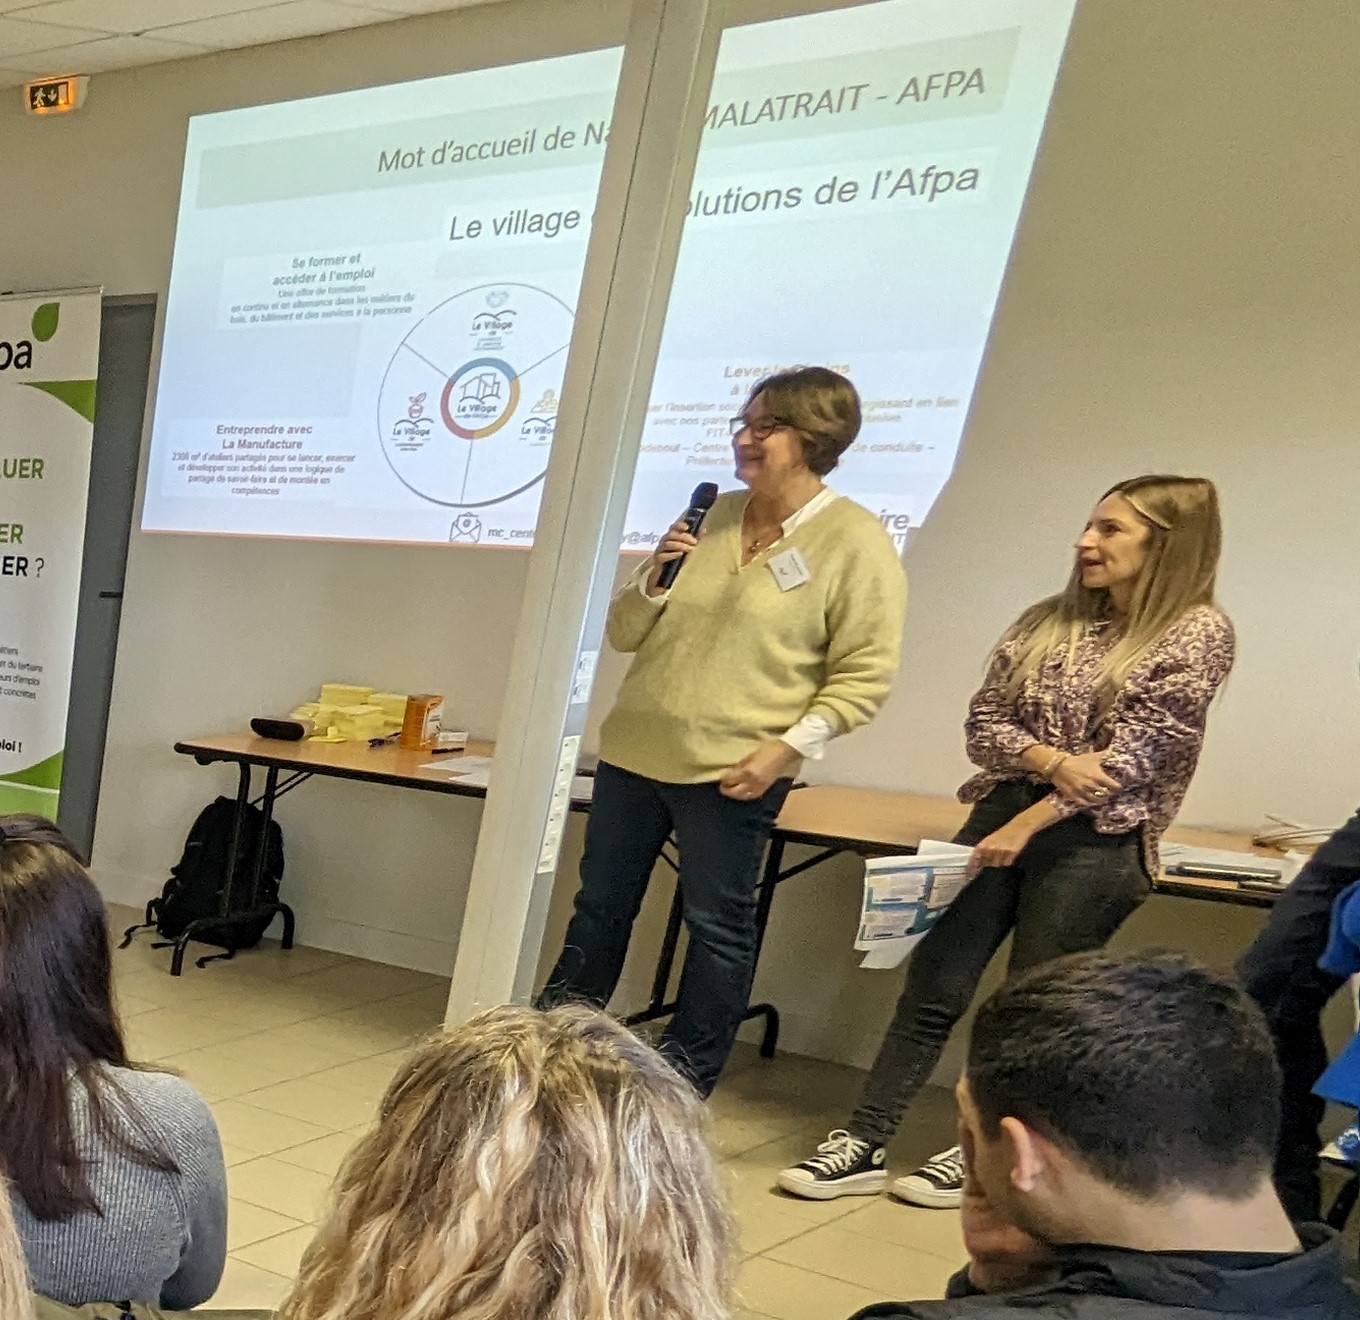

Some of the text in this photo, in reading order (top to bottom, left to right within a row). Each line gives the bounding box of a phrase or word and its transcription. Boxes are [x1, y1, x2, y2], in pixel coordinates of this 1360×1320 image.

[876, 94, 888, 102] -
[895, 67, 986, 106] AFPA
[377, 147, 426, 173] Mot
[544, 125, 576, 151] de
[814, 175, 859, 206] de
[449, 209, 581, 241] Le village
[292, 253, 362, 269] Se former et
[216, 424, 313, 437] Entreprendre avec
[222, 439, 303, 450] La Manufacture
[35, 557, 45, 578] ?
